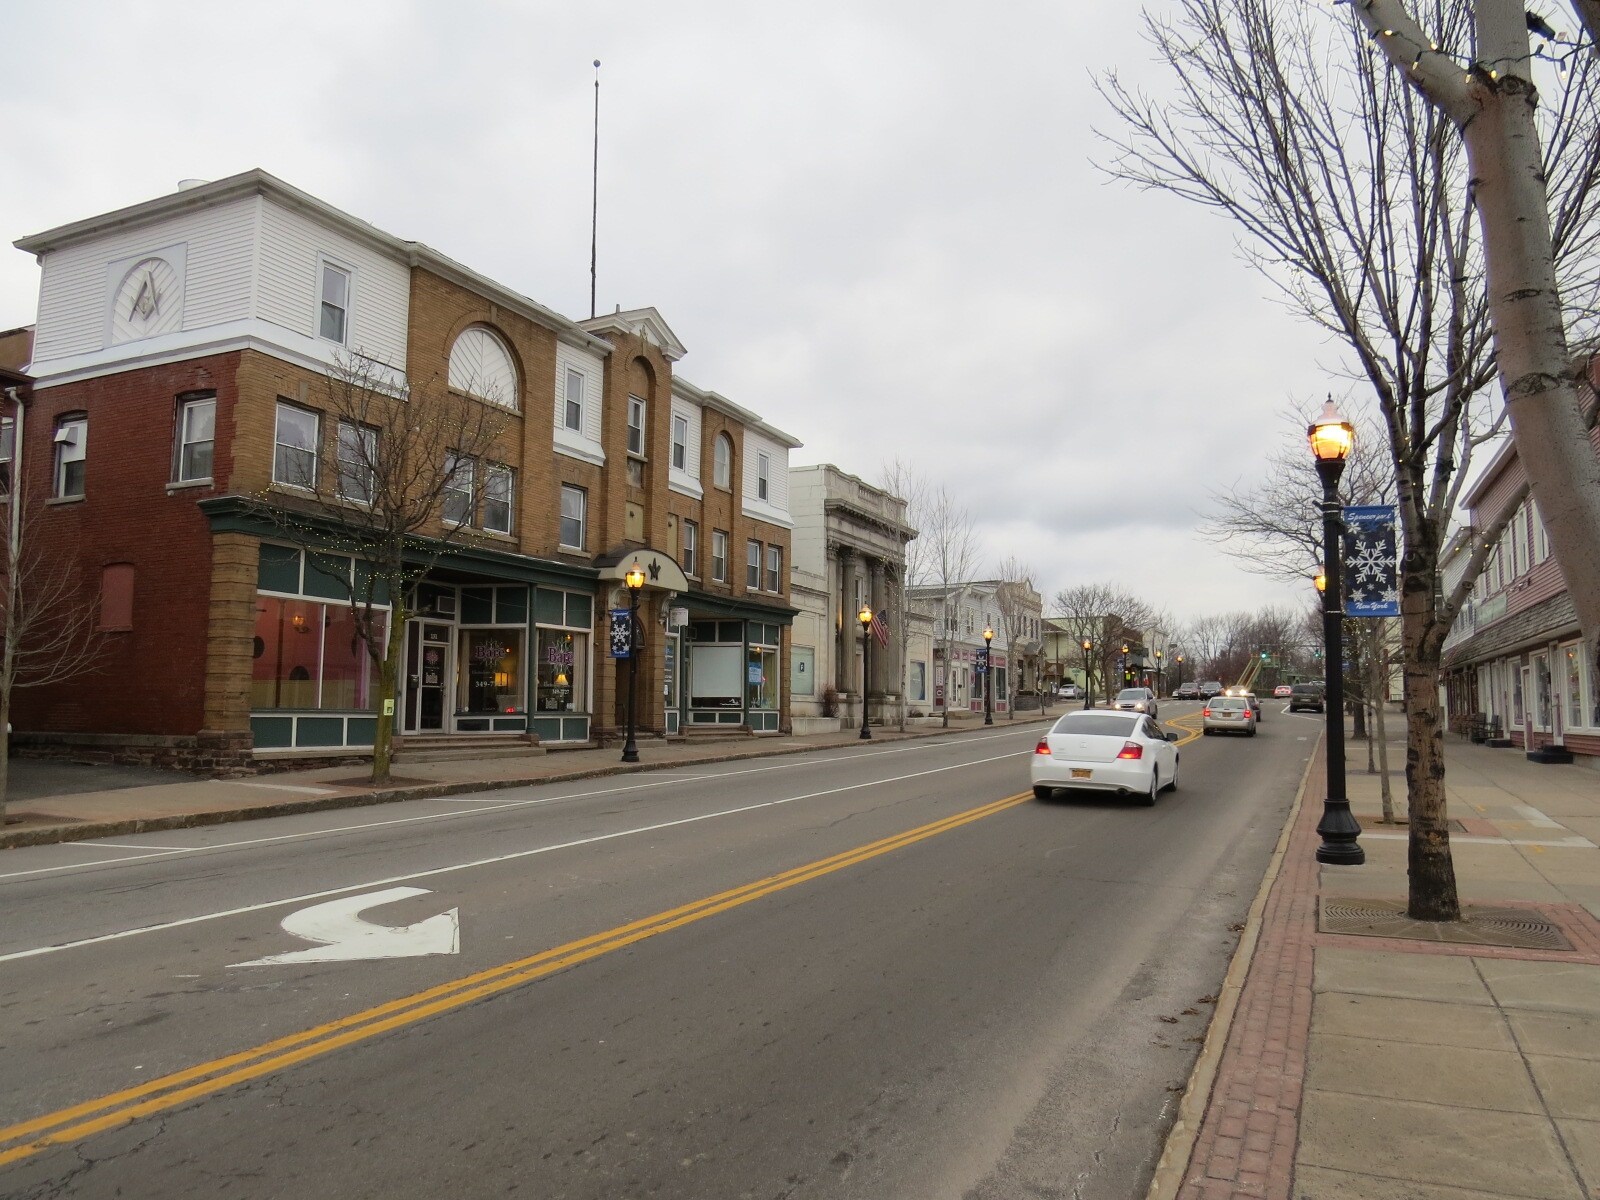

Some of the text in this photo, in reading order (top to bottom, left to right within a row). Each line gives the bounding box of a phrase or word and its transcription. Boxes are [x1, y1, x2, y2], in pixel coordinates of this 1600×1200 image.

[1355, 602, 1388, 611] New York
[475, 645, 505, 659] Bare
[547, 647, 574, 665] Bare
